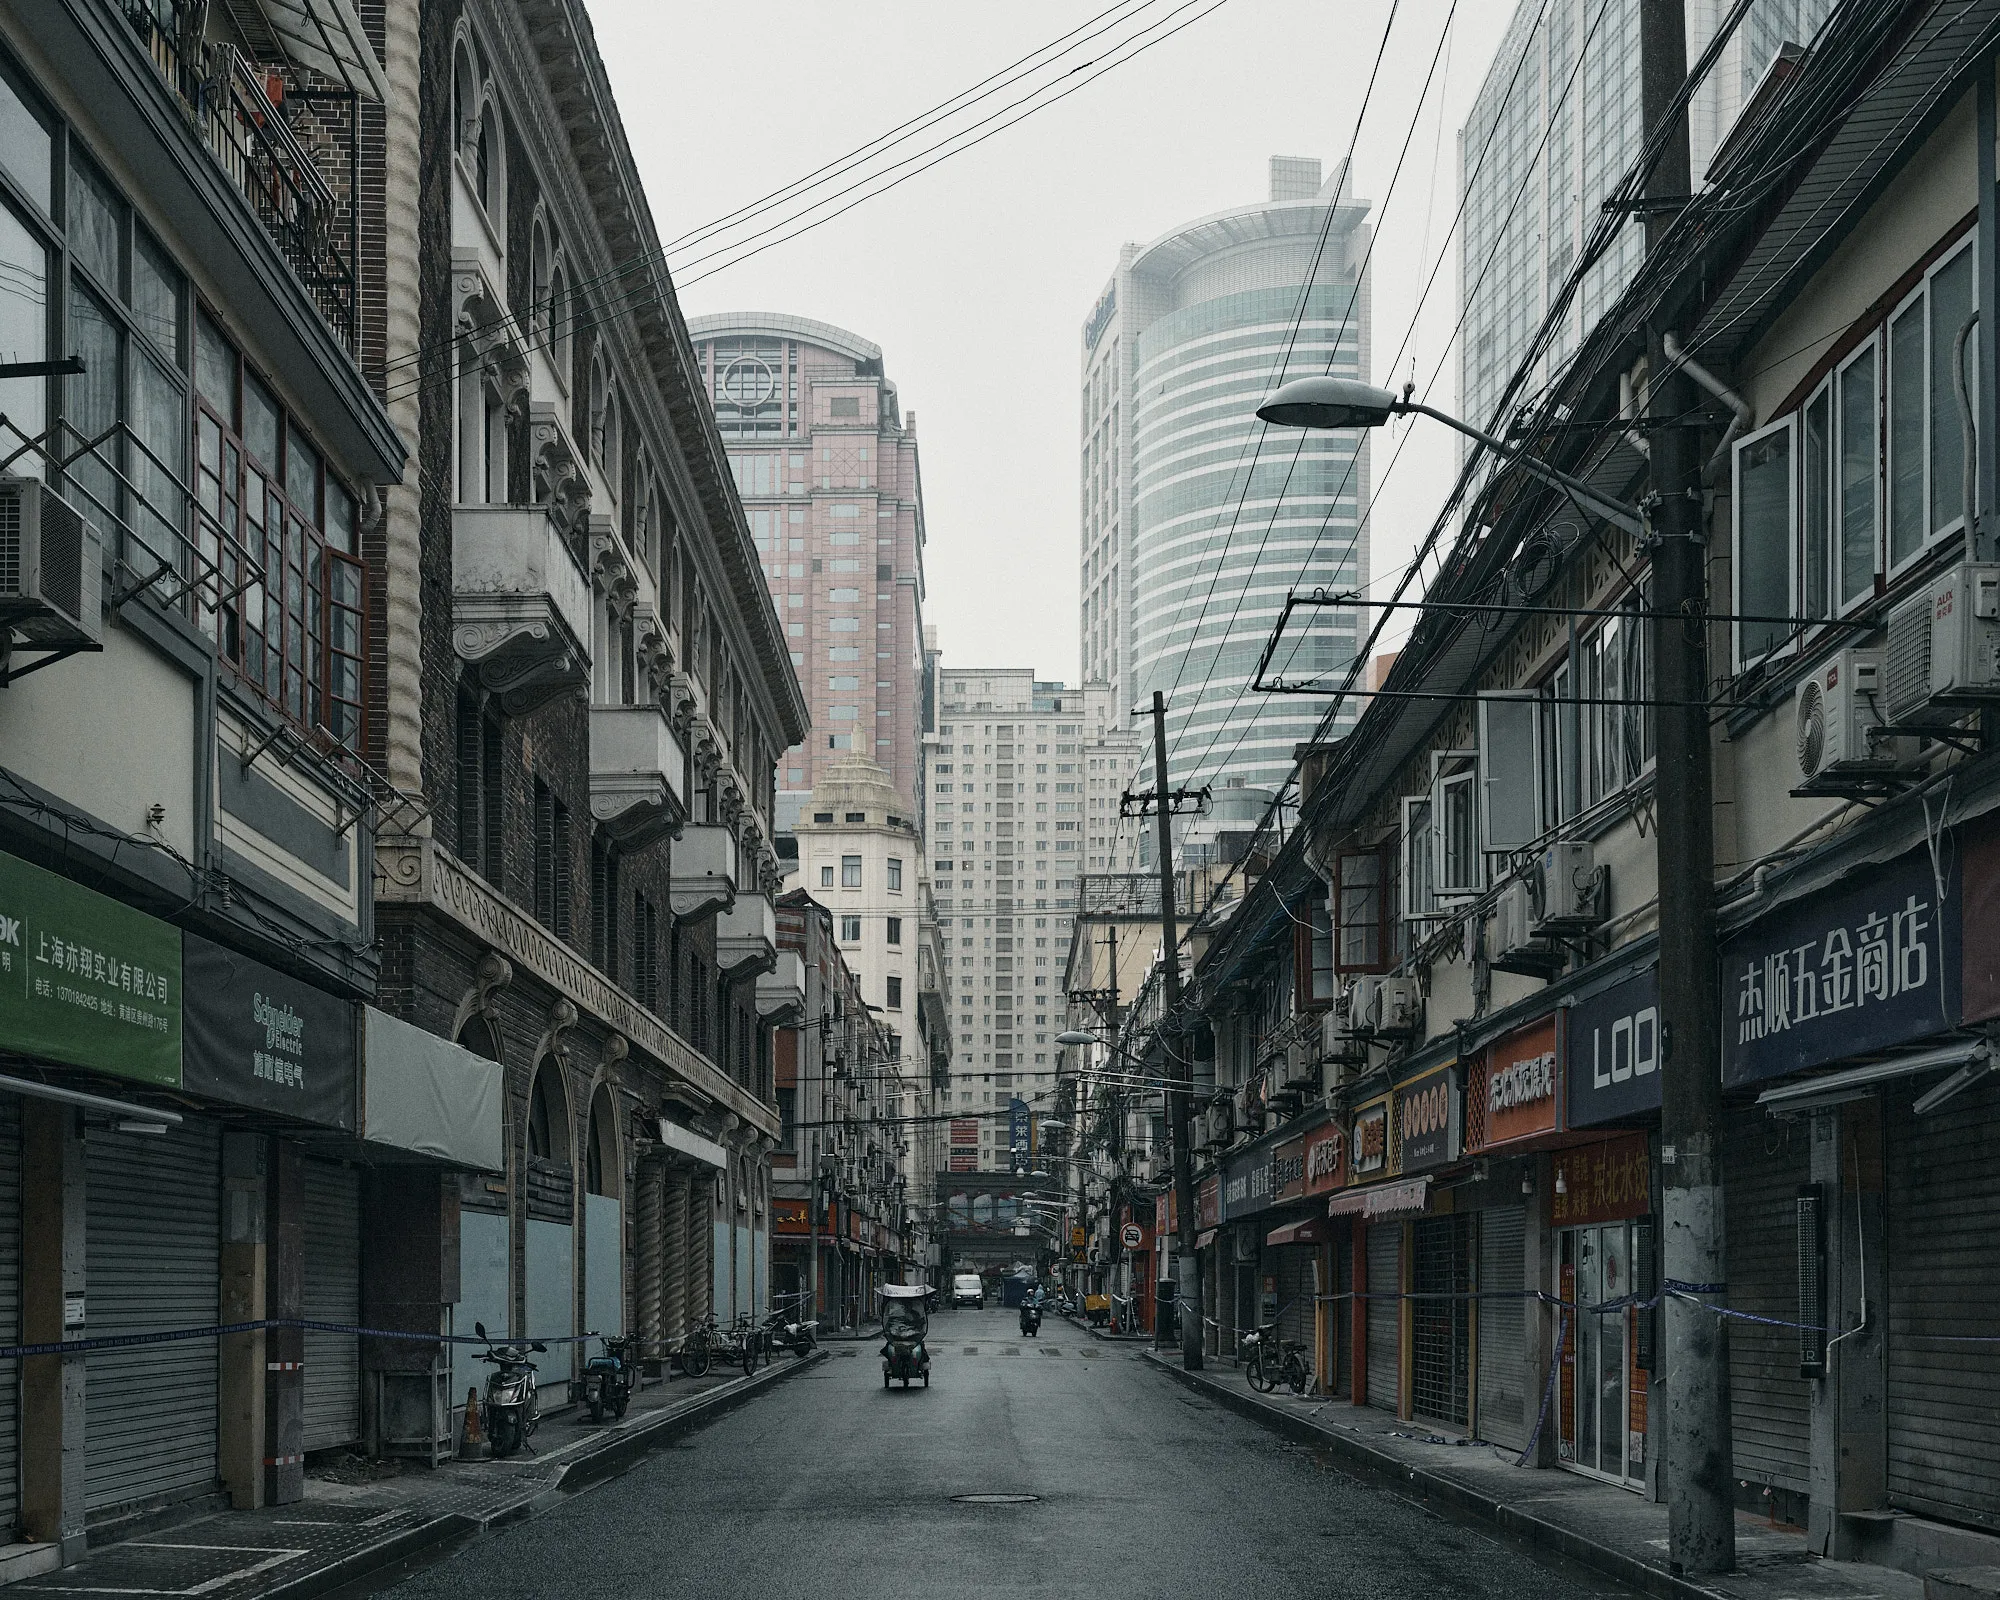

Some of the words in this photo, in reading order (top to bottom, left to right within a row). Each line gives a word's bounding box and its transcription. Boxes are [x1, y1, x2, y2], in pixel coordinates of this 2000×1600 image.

[1936, 589, 1954, 608] AUX
[36, 931, 168, 1005] 上海亦翔实业有限公司
[1738, 894, 1929, 1045] 杰顺五金商店
[253, 992, 303, 1040] Schneider
[275, 1029, 303, 1056] Electric
[1593, 1006, 1662, 1090] LOO
[1593, 1149, 1649, 1209] 东北水饺
